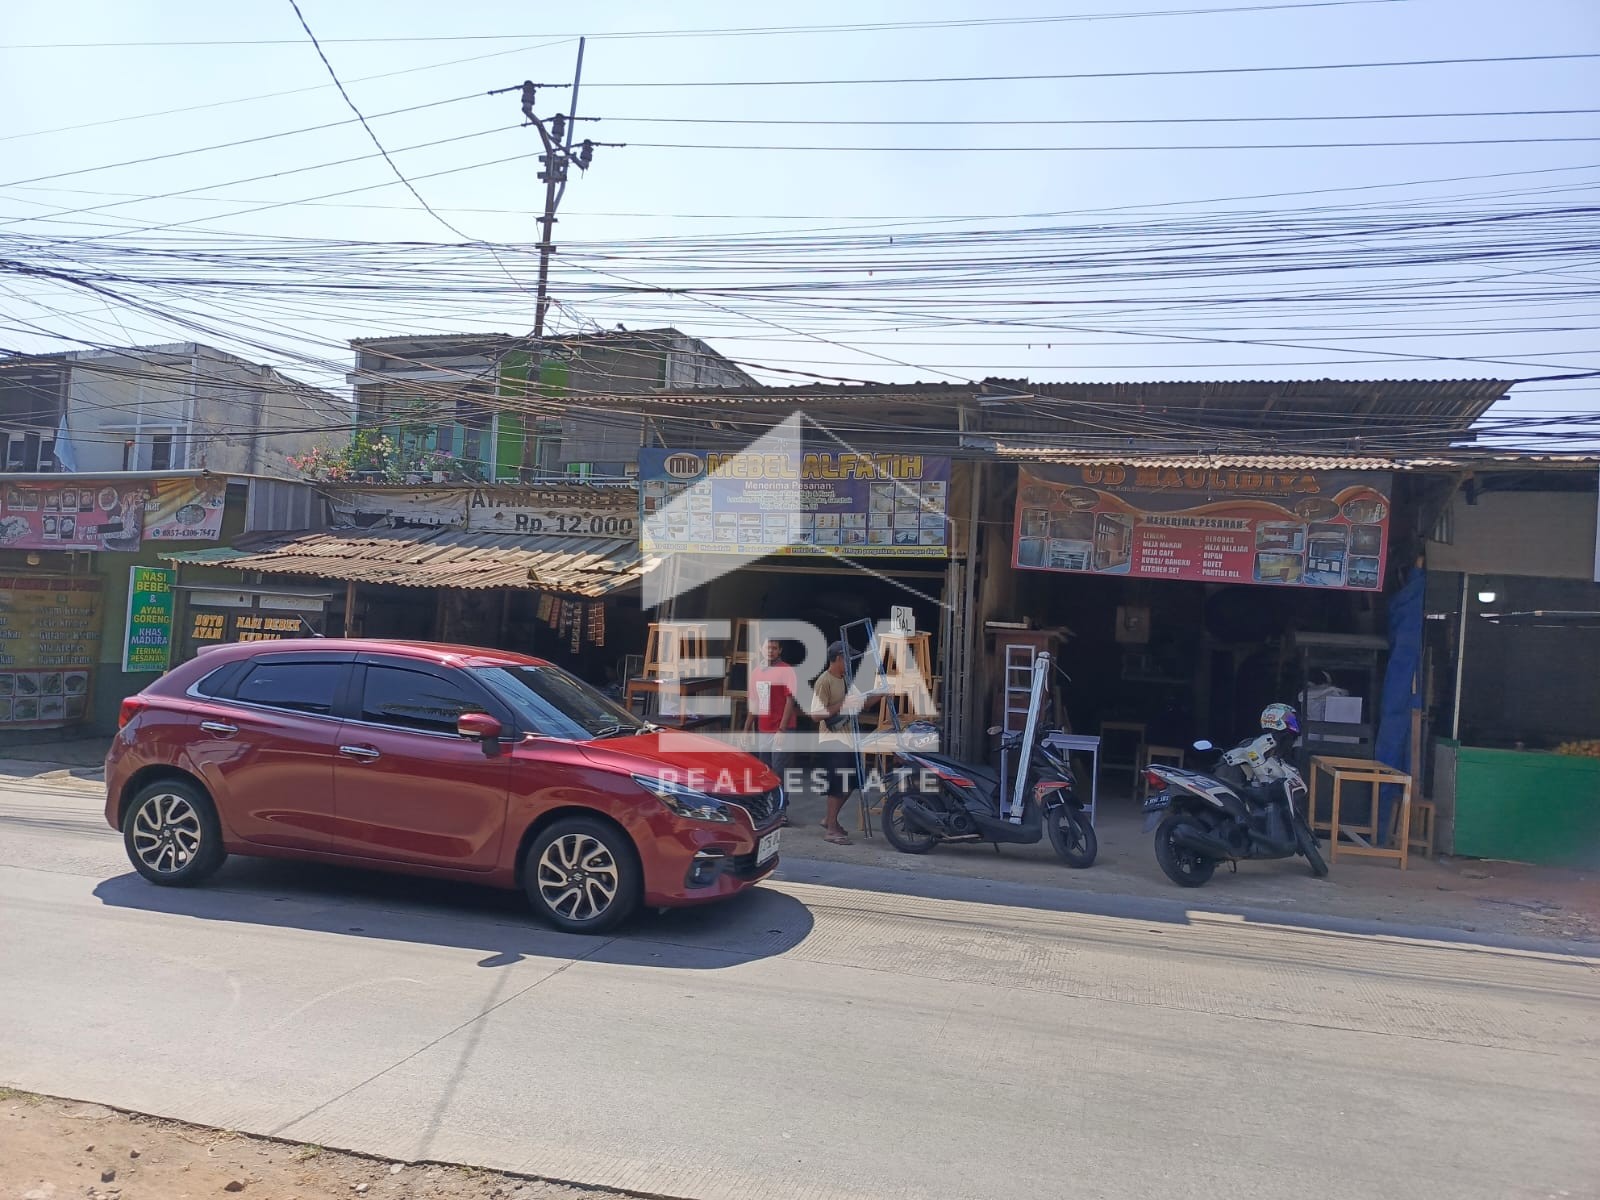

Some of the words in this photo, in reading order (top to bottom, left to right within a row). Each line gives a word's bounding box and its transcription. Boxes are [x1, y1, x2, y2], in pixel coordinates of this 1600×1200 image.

[707, 453, 798, 479] MEBEL
[802, 453, 923, 479] ALFATIH
[745, 481, 790, 490] Menerima
[556, 514, 633, 534] 12.000
[1146, 516, 1196, 527] MENERIMA
[1199, 518, 1244, 529] PESANAN
[142, 571, 167, 582] NASI
[136, 581, 171, 593] BEBEK
[140, 606, 165, 615] AYAM
[133, 614, 170, 624] GORENG
[194, 614, 224, 627] SOTO
[263, 618, 302, 632] BEBEK
[138, 627, 162, 637] KHAS
[191, 626, 223, 640] AYAM
[131, 636, 168, 645] MADURA
